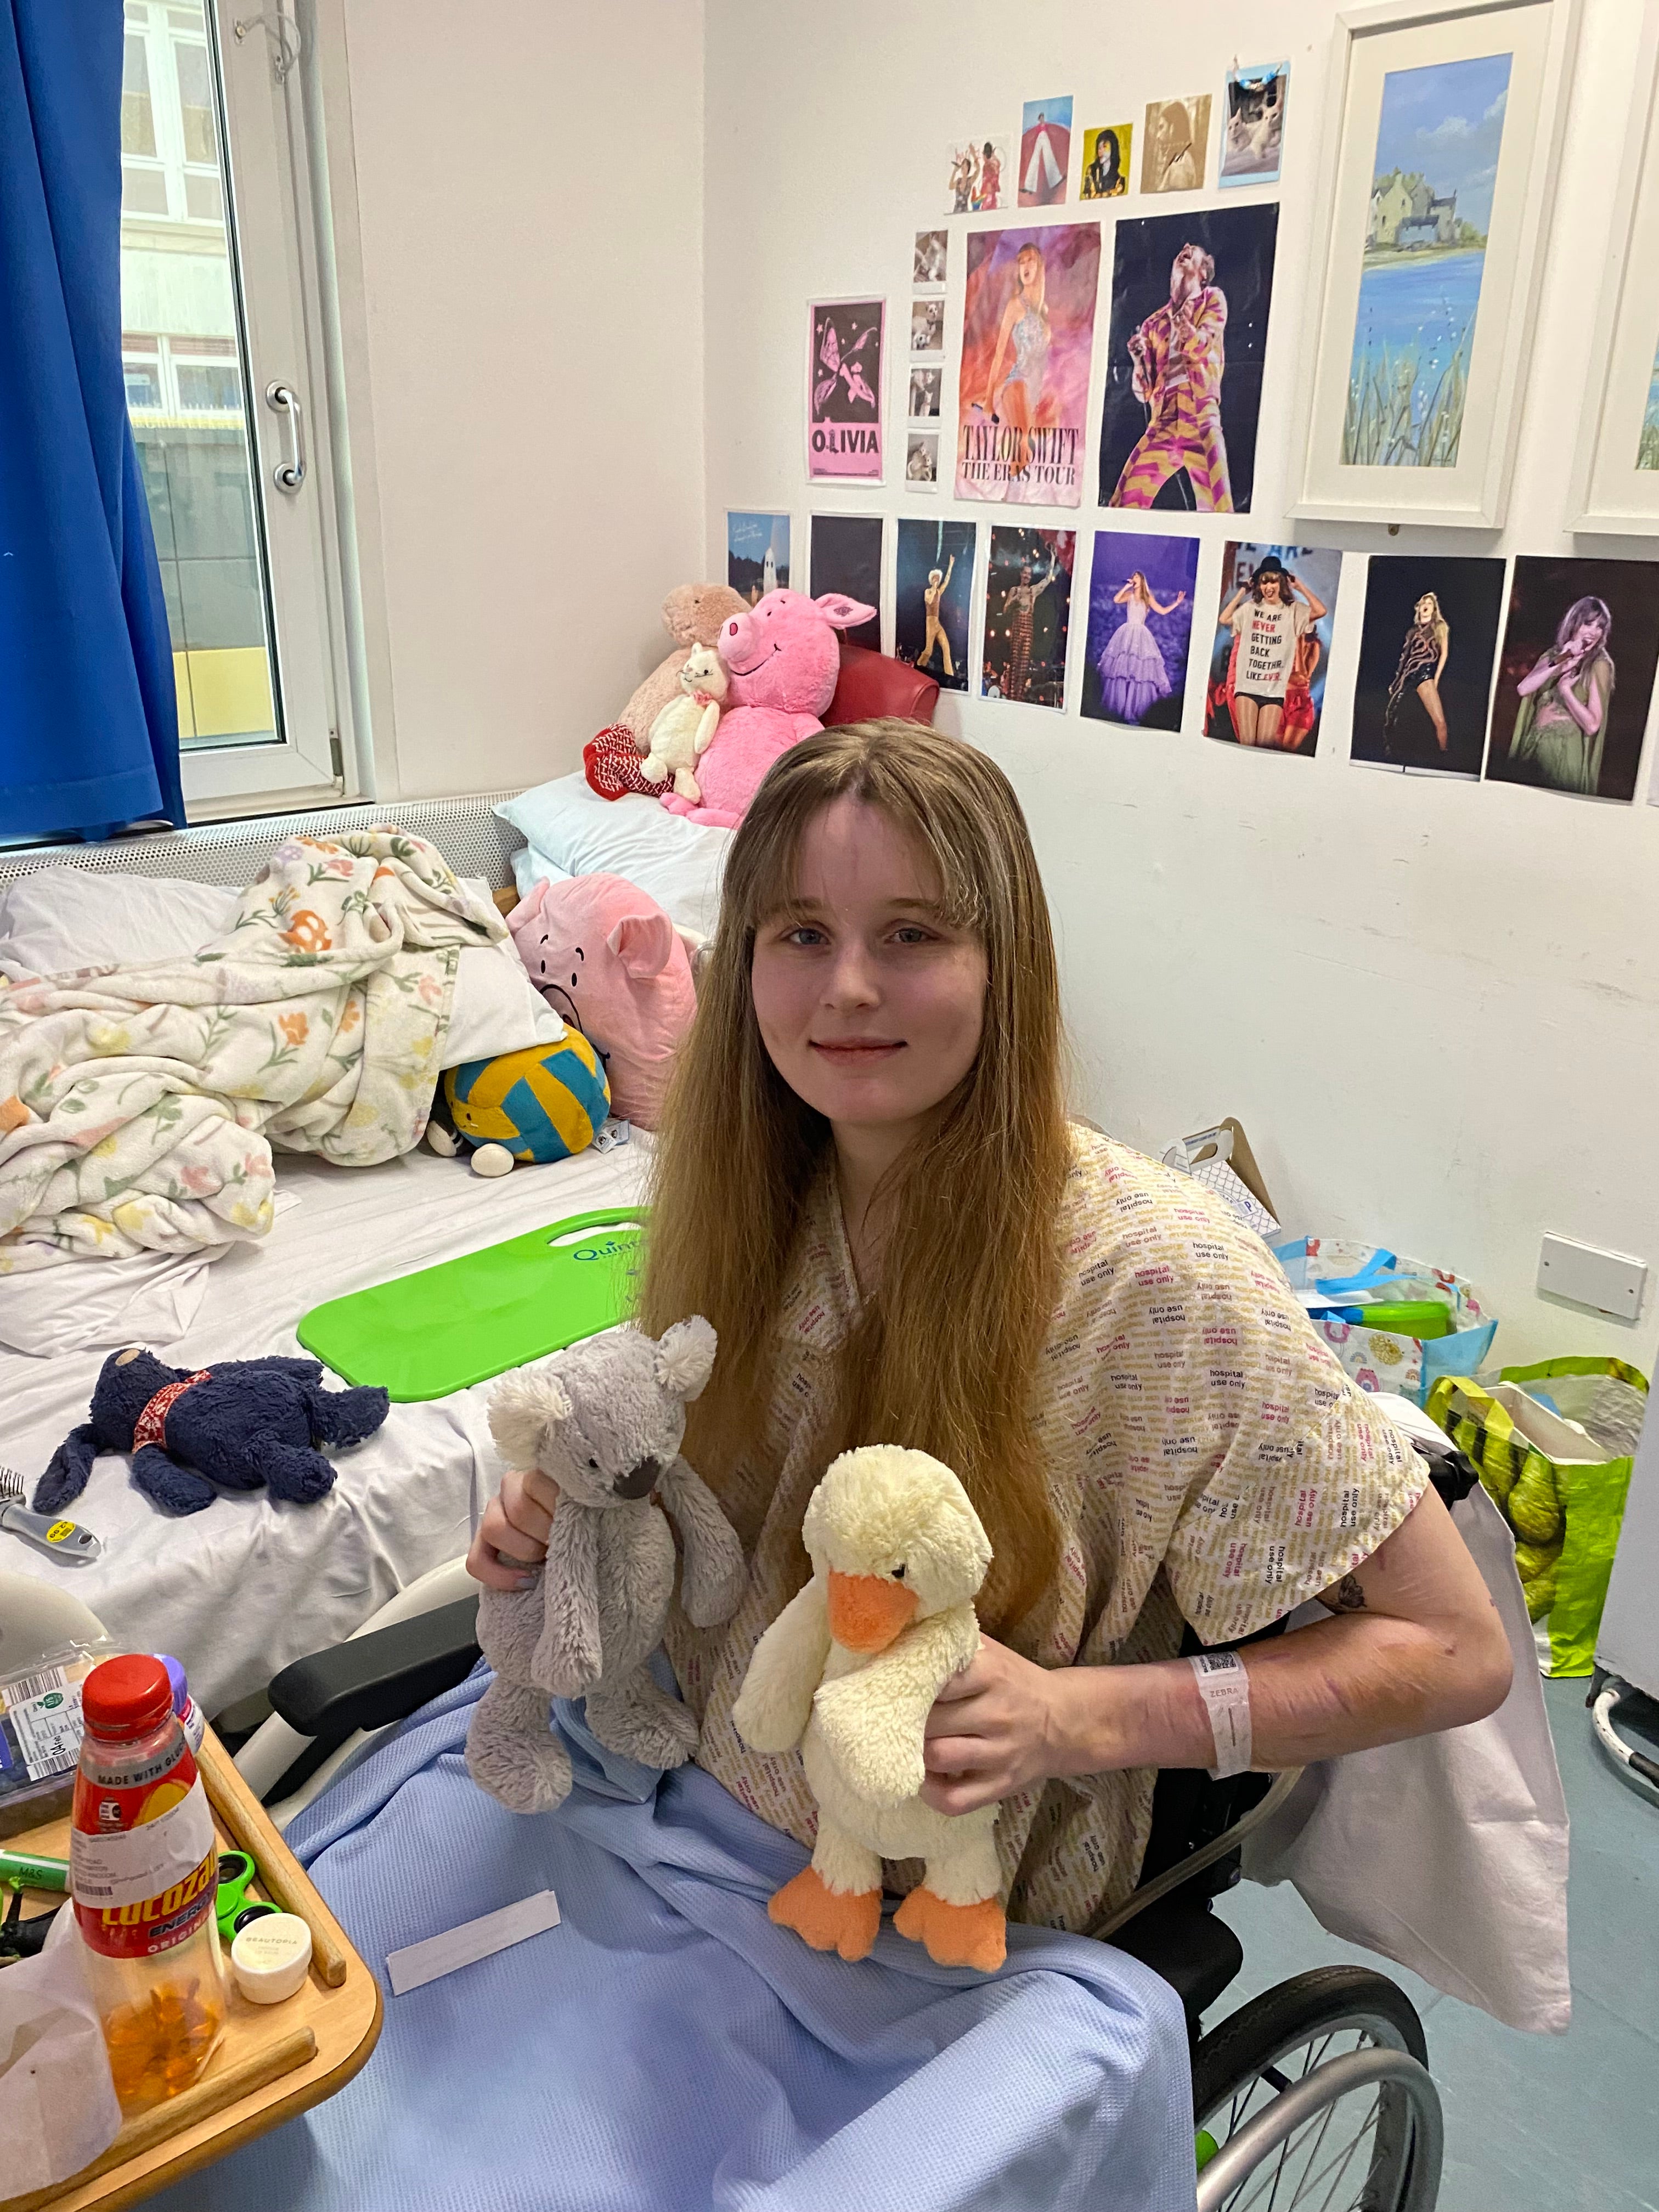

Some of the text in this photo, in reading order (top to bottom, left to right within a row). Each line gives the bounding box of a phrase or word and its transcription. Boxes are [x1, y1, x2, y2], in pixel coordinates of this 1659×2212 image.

[812, 430, 879, 453] OLIVIA
[963, 425, 1079, 465] TAYLOR SWIFT
[962, 462, 1075, 485] THE ERAS TOUR
[1254, 608, 1264, 618] WE
[1252, 620, 1276, 632] NEVER
[1251, 633, 1282, 645] GETTING
[1250, 646, 1270, 657] BACK
[1246, 670, 1261, 680] LIKE
[1193, 1242, 1224, 1251] hospital
[1097, 1267, 1114, 1280] only
[1135, 1265, 1170, 1278] hospital
[1138, 1277, 1154, 1286] use
[1156, 1275, 1173, 1284] only
[1149, 1304, 1183, 1315] use only
[1152, 1314, 1186, 1324] hospital
[1210, 1369, 1243, 1378] hospital
[1229, 1380, 1245, 1389] only
[1309, 1488, 1317, 1508] only
[1295, 1490, 1307, 1526] hospital
[1340, 1491, 1350, 1527] hospital
[1276, 1546, 1285, 1582] hospital
[1210, 1686, 1239, 1698] ZEBRA
[97, 1775, 129, 1785] MADE
[133, 1763, 163, 1782] WITH
[165, 1734, 186, 1767] GLUC
[19, 1866, 43, 1880] M&S
